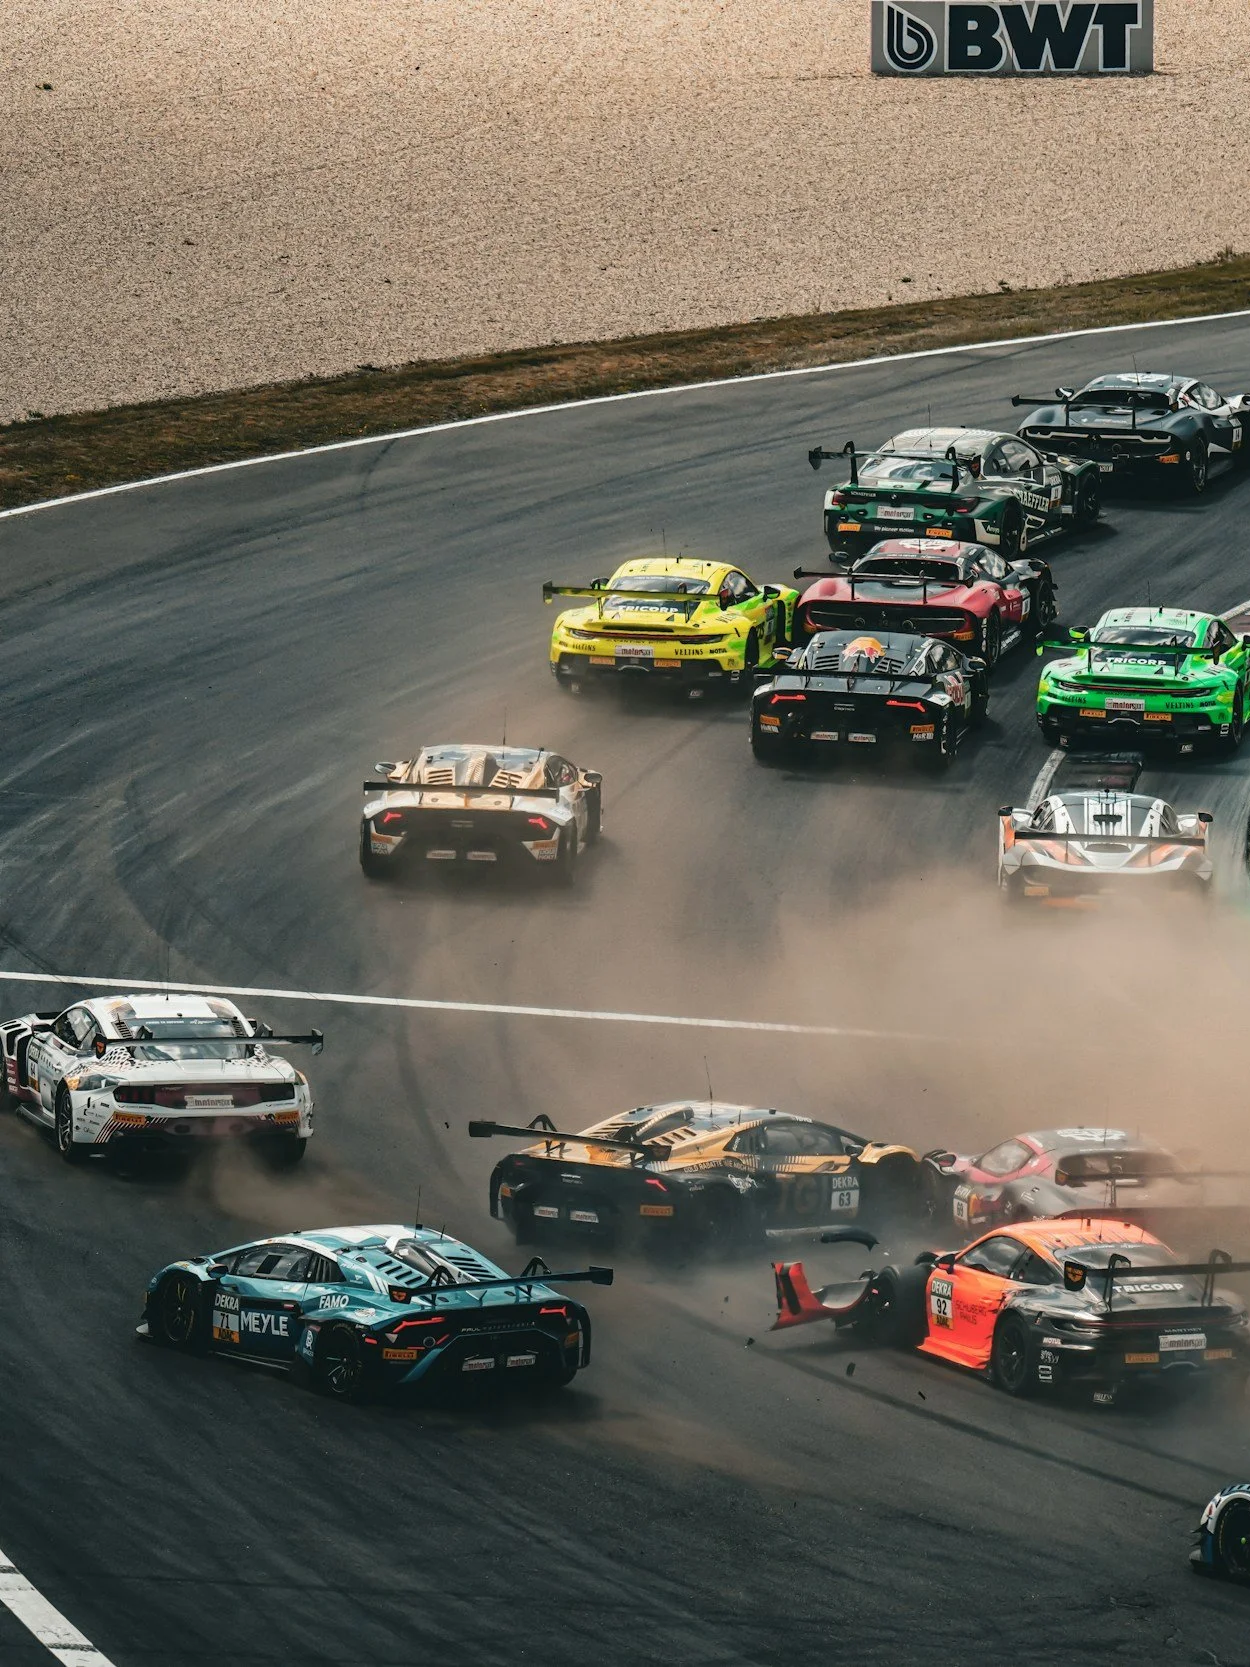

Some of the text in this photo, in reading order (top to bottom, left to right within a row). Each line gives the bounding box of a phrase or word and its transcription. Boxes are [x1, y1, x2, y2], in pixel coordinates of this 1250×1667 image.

[946, 2, 1140, 70] BWT
[618, 604, 679, 613] TRICORP
[1106, 657, 1167, 666] TRICORP
[1165, 701, 1195, 709] VELTINS
[115, 1113, 142, 1123] PIRELLI
[683, 1164, 699, 1173] GOLD
[832, 1175, 859, 1189] DEKRA
[838, 1192, 851, 1207] 63
[931, 1280, 952, 1298] DEKRA
[1112, 1283, 1184, 1293] TRICORP
[214, 1293, 240, 1311] DEKRA
[319, 1294, 350, 1309] FAMO
[936, 1298, 947, 1316] 92
[220, 1312, 231, 1329] 71
[241, 1310, 290, 1338] MEYLE
